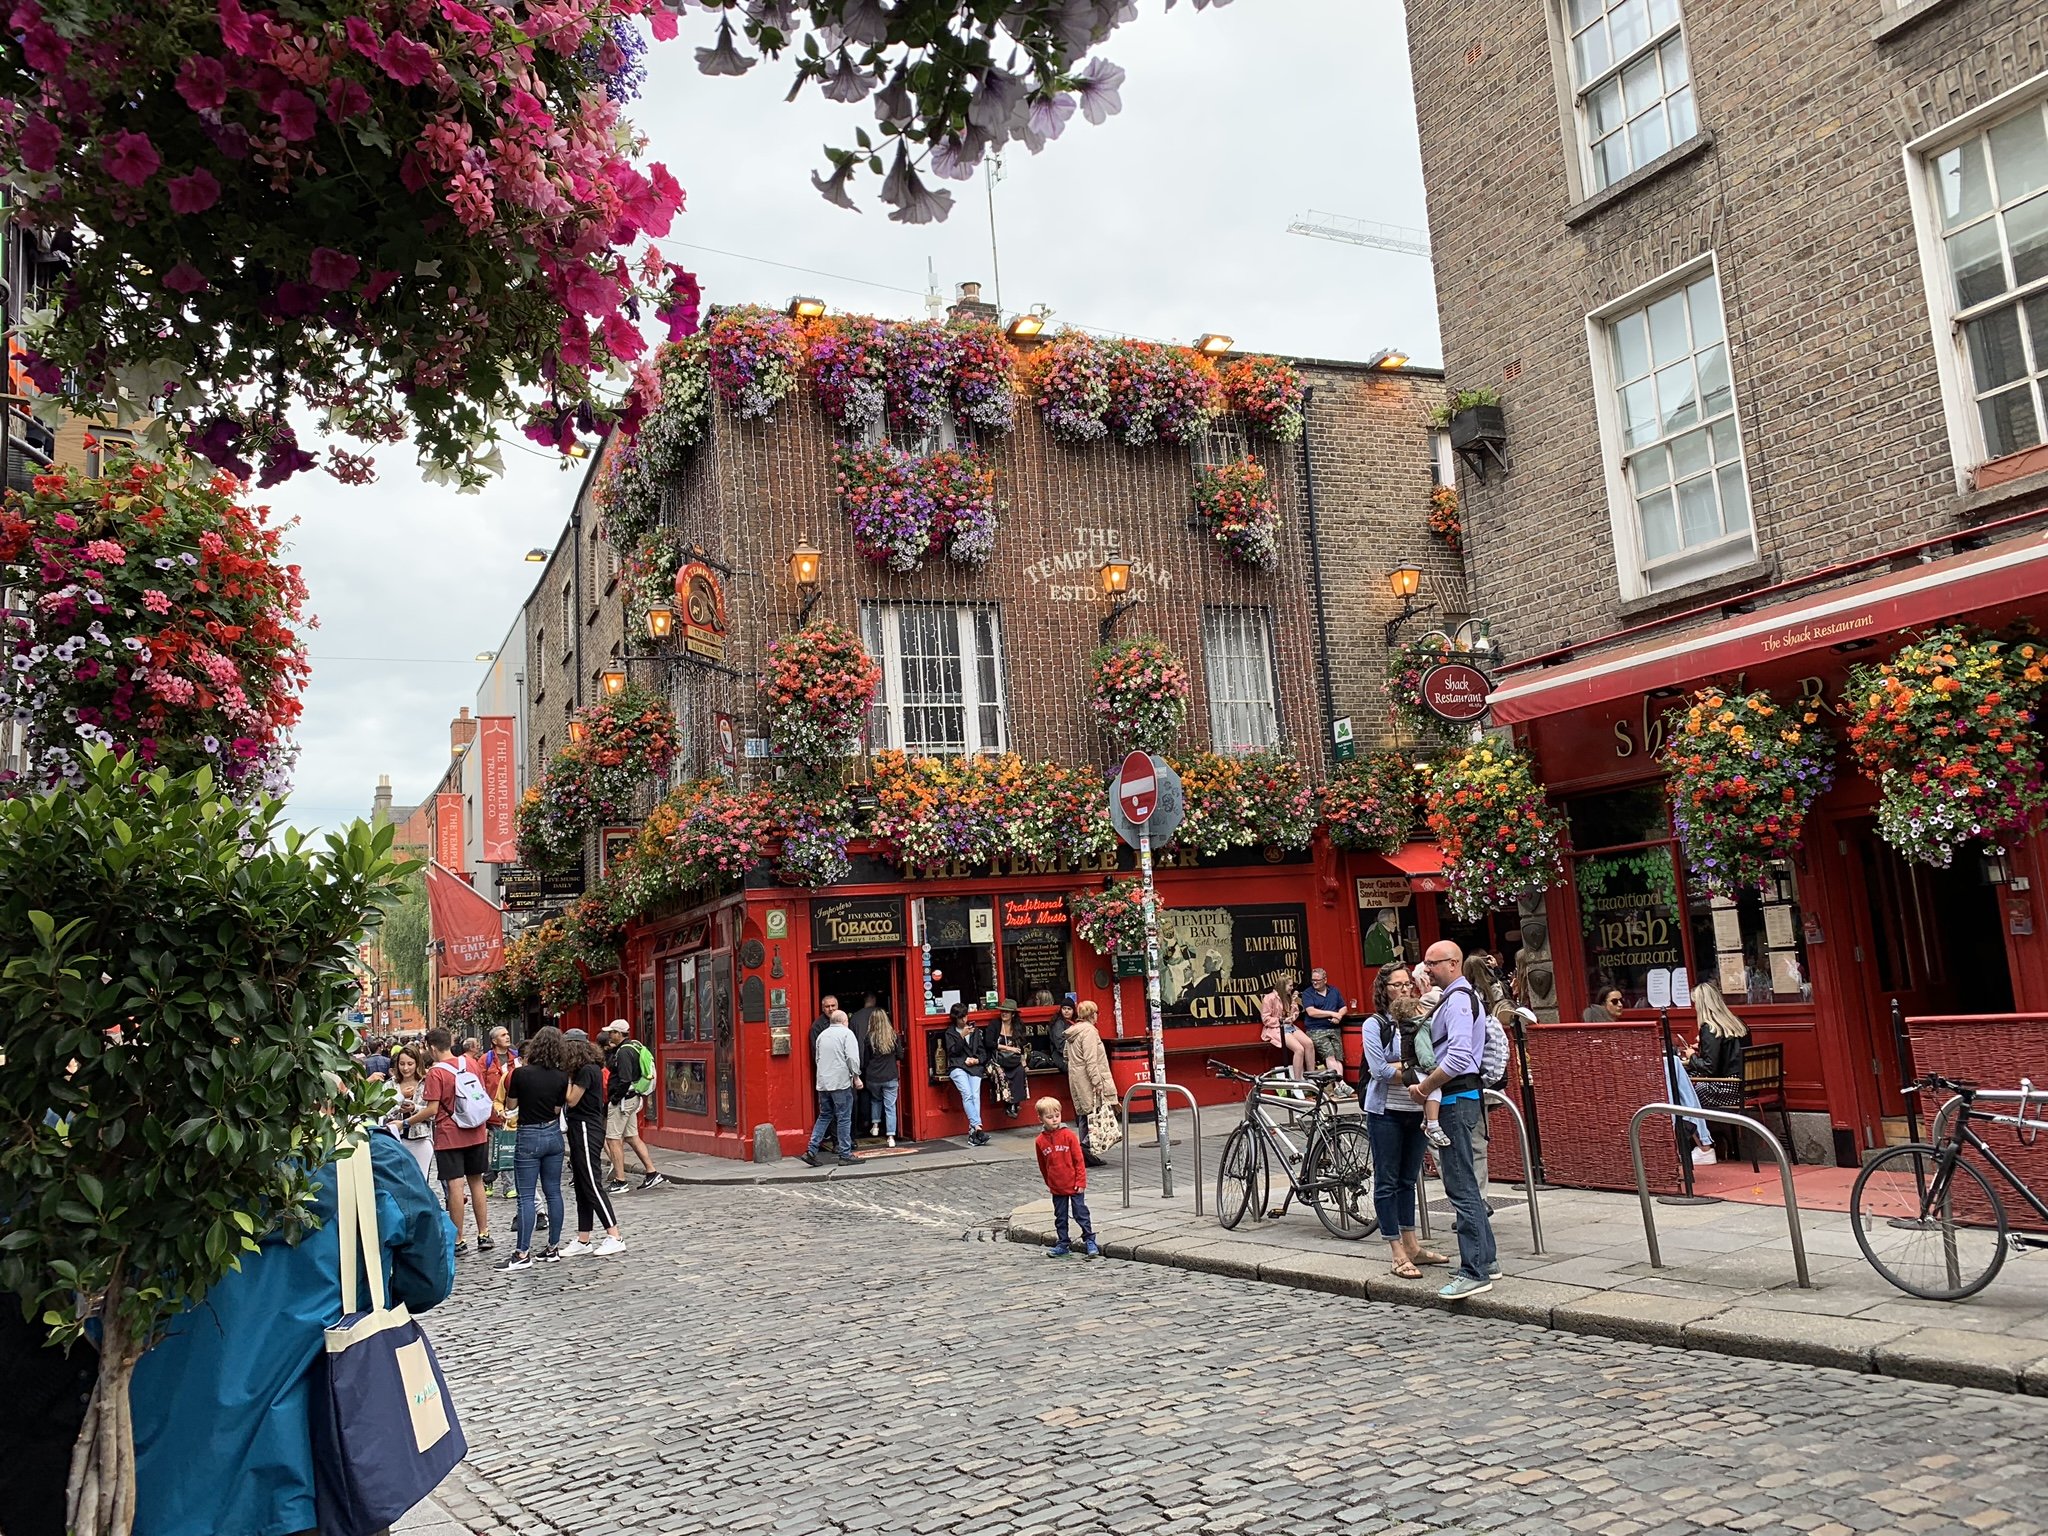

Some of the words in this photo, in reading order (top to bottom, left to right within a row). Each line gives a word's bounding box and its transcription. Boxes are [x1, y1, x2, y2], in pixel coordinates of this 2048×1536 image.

[1073, 527, 1120, 548] THE
[688, 566, 715, 583] TEMPLE
[1129, 555, 1172, 590] BAR
[1050, 585, 1101, 601] ESTD.
[694, 629, 716, 642] DUBLIN
[1761, 635, 1781, 652] The
[1783, 625, 1811, 645] Shack
[1813, 614, 1874, 639] Restaurant
[691, 641, 703, 652] LIVE
[704, 646, 721, 658] MUSIC
[1434, 692, 1483, 704] Restaurant
[496, 739, 507, 762] THE
[486, 755, 496, 801] TRADING
[497, 764, 508, 810] TEMPLE
[487, 803, 496, 819] CO.
[449, 813, 457, 831] THE
[498, 813, 509, 835] BAR
[441, 825, 449, 862] TRADING
[450, 832, 459, 867] TEMPLE
[898, 852, 972, 879] THE
[1359, 880, 1375, 889] Beer
[1376, 880, 1401, 888] Garden
[1360, 889, 1388, 898] Smoking
[814, 901, 852, 919] Importers
[1004, 896, 1064, 913] Traditional
[1366, 899, 1382, 907] Area
[863, 911, 892, 919] SMOKING
[1004, 912, 1032, 927] Irish
[1036, 910, 1067, 924] Music
[1171, 913, 1229, 927] TEMPLE
[825, 917, 893, 942] TOBACCO
[1190, 925, 1217, 938] BAR
[1272, 919, 1296, 934] THE
[451, 938, 501, 954] TEMPLE
[464, 934, 485, 943] THE
[1017, 931, 1042, 945] TEMPLE
[1245, 936, 1297, 952] EMPEROR
[464, 950, 490, 962] BAR
[1285, 952, 1298, 967] OF
[1216, 975, 1259, 993] MALTED
[1190, 994, 1266, 1019] GUINN
